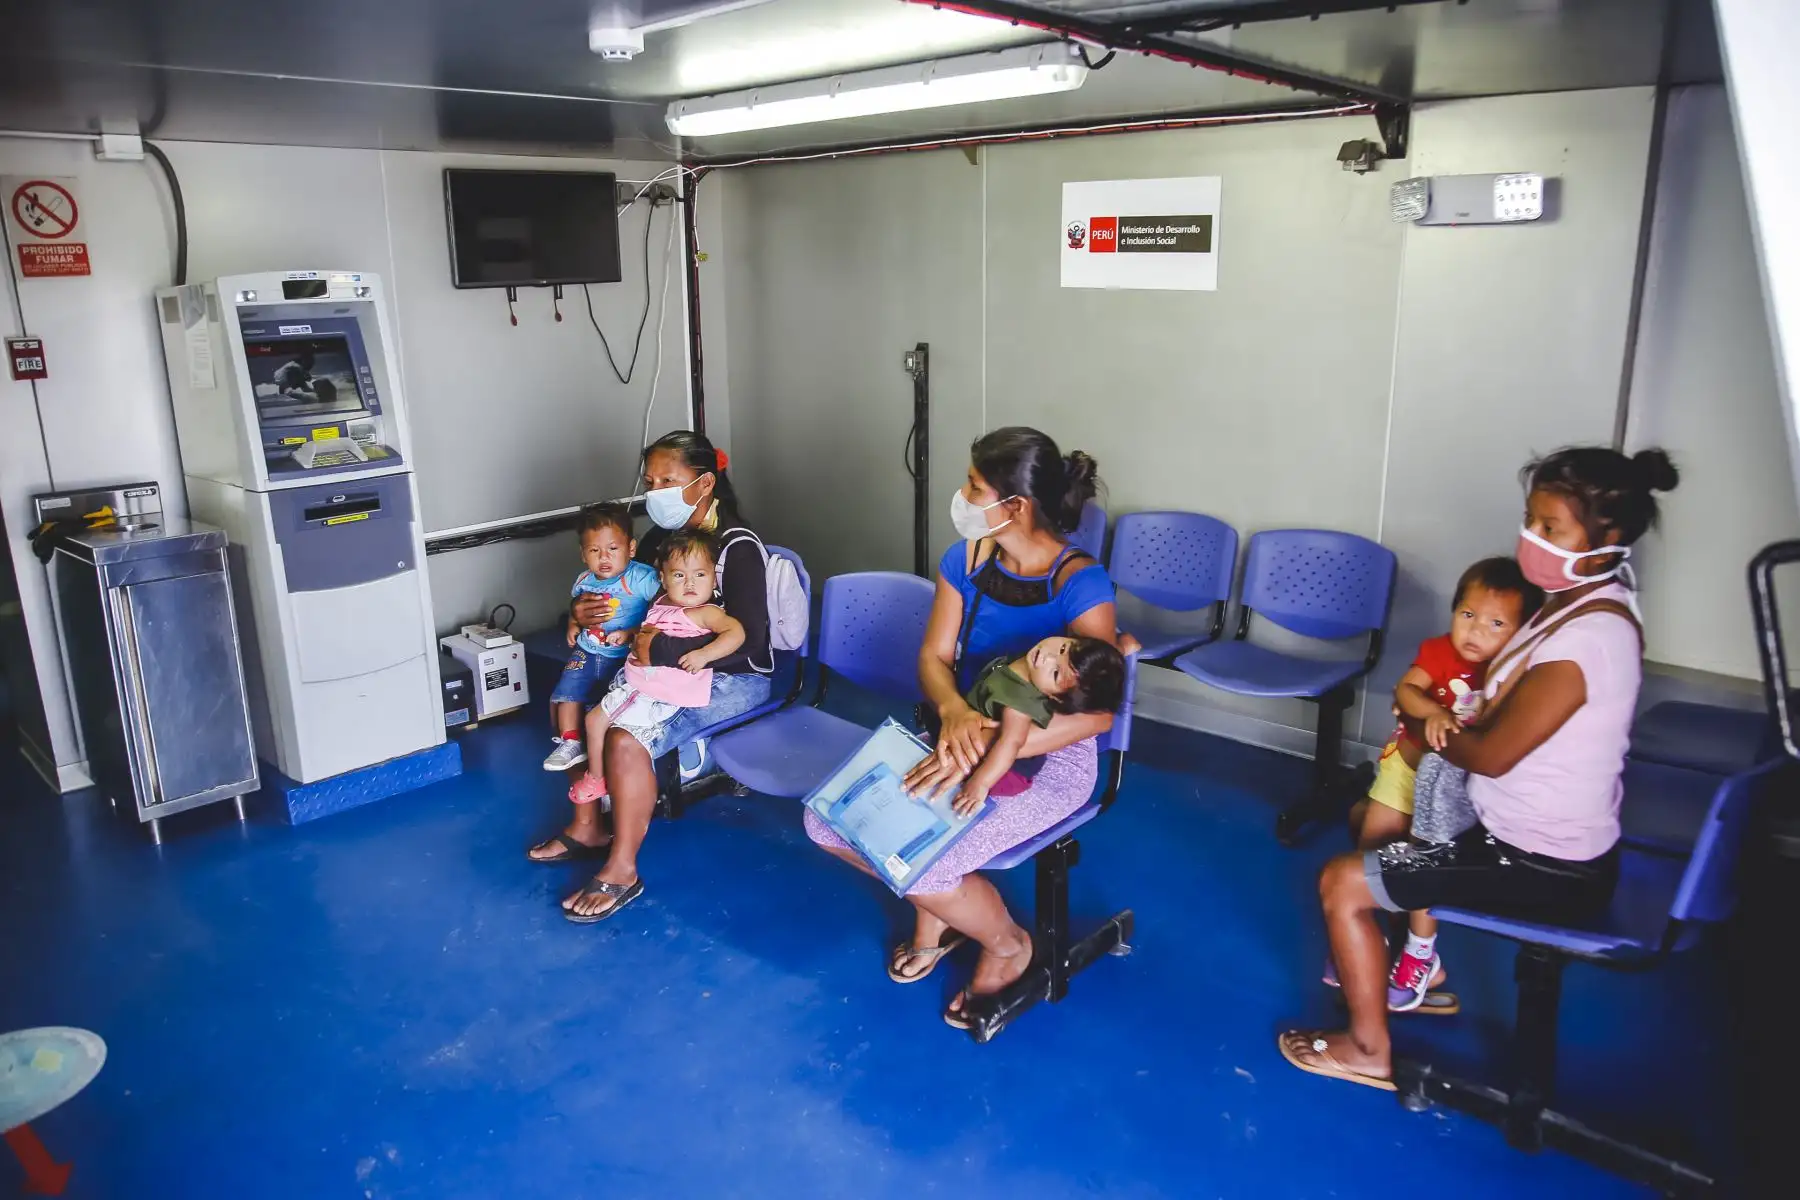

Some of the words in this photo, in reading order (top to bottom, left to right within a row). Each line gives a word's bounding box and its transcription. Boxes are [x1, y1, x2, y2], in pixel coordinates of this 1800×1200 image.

[1092, 228, 1113, 240] PERÚ
[1121, 225, 1155, 234] Ministerio
[1155, 225, 1164, 234] de
[1165, 225, 1201, 234] Desarrollo
[1126, 236, 1156, 245] Inclusión
[1156, 236, 1176, 245] Social
[22, 245, 84, 255] PROHIBIDO
[36, 254, 74, 264] FUMAR
[18, 359, 42, 369] FIRE
